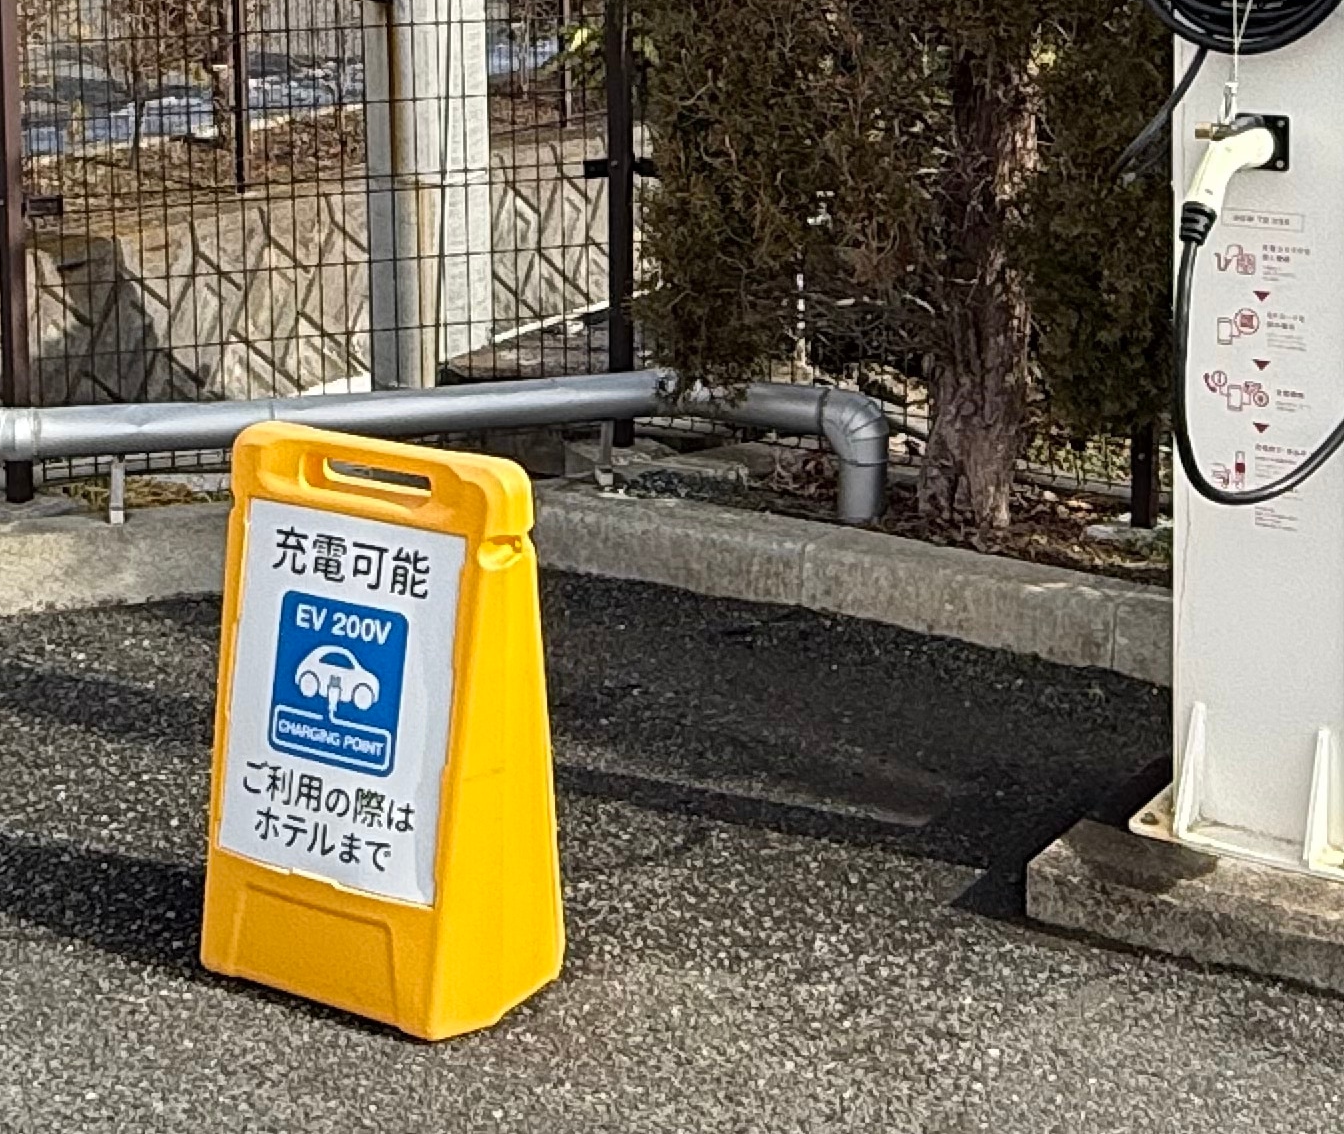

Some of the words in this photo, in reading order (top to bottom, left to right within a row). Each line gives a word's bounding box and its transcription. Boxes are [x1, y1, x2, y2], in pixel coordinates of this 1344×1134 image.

[272, 526, 430, 599] 充電可能
[296, 603, 328, 632] EV
[331, 612, 392, 645] 200V
[278, 719, 341, 747] CHARGING
[342, 734, 385, 757] POINT
[243, 760, 416, 832] ご利用の際は
[254, 806, 392, 872] ホテルまで
